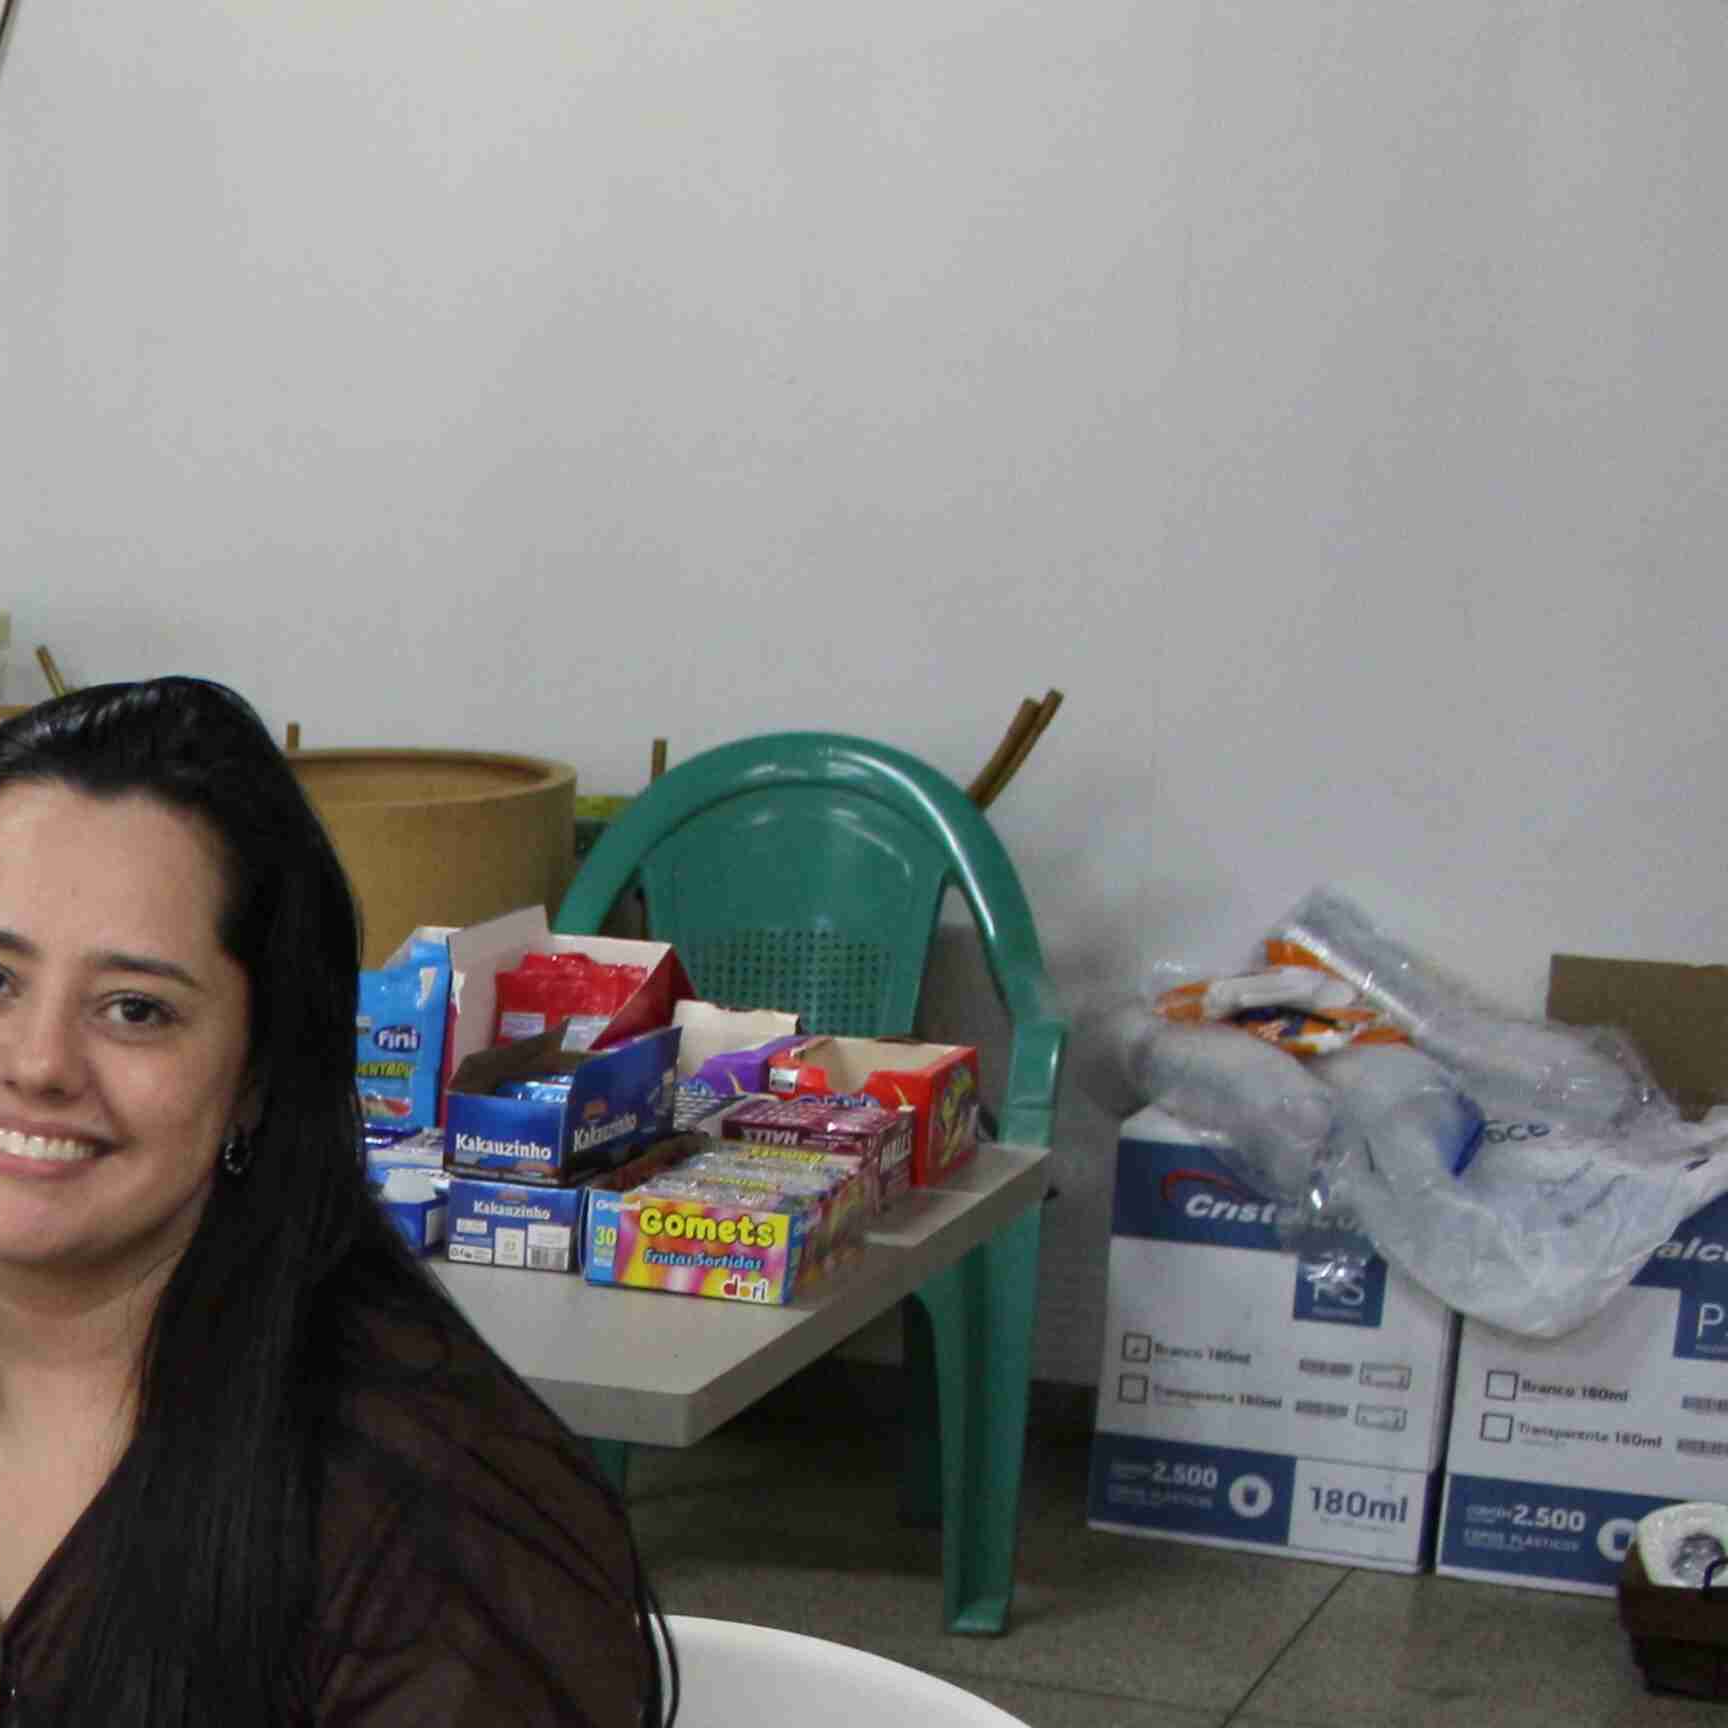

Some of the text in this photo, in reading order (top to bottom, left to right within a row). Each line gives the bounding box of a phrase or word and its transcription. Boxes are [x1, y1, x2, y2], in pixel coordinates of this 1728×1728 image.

[456, 1133, 551, 1161] Kakauzinho
[474, 1200, 550, 1220] Kakauzinho
[594, 1226, 617, 1247] 30
[640, 1207, 777, 1248] Gomets
[644, 1249, 765, 1271] Frutas Sortidas
[722, 1274, 770, 1302] dori
[1696, 1303, 1728, 1338] P
[1309, 1484, 1409, 1524] 180ml
[1511, 1503, 1586, 1532] 2.500
